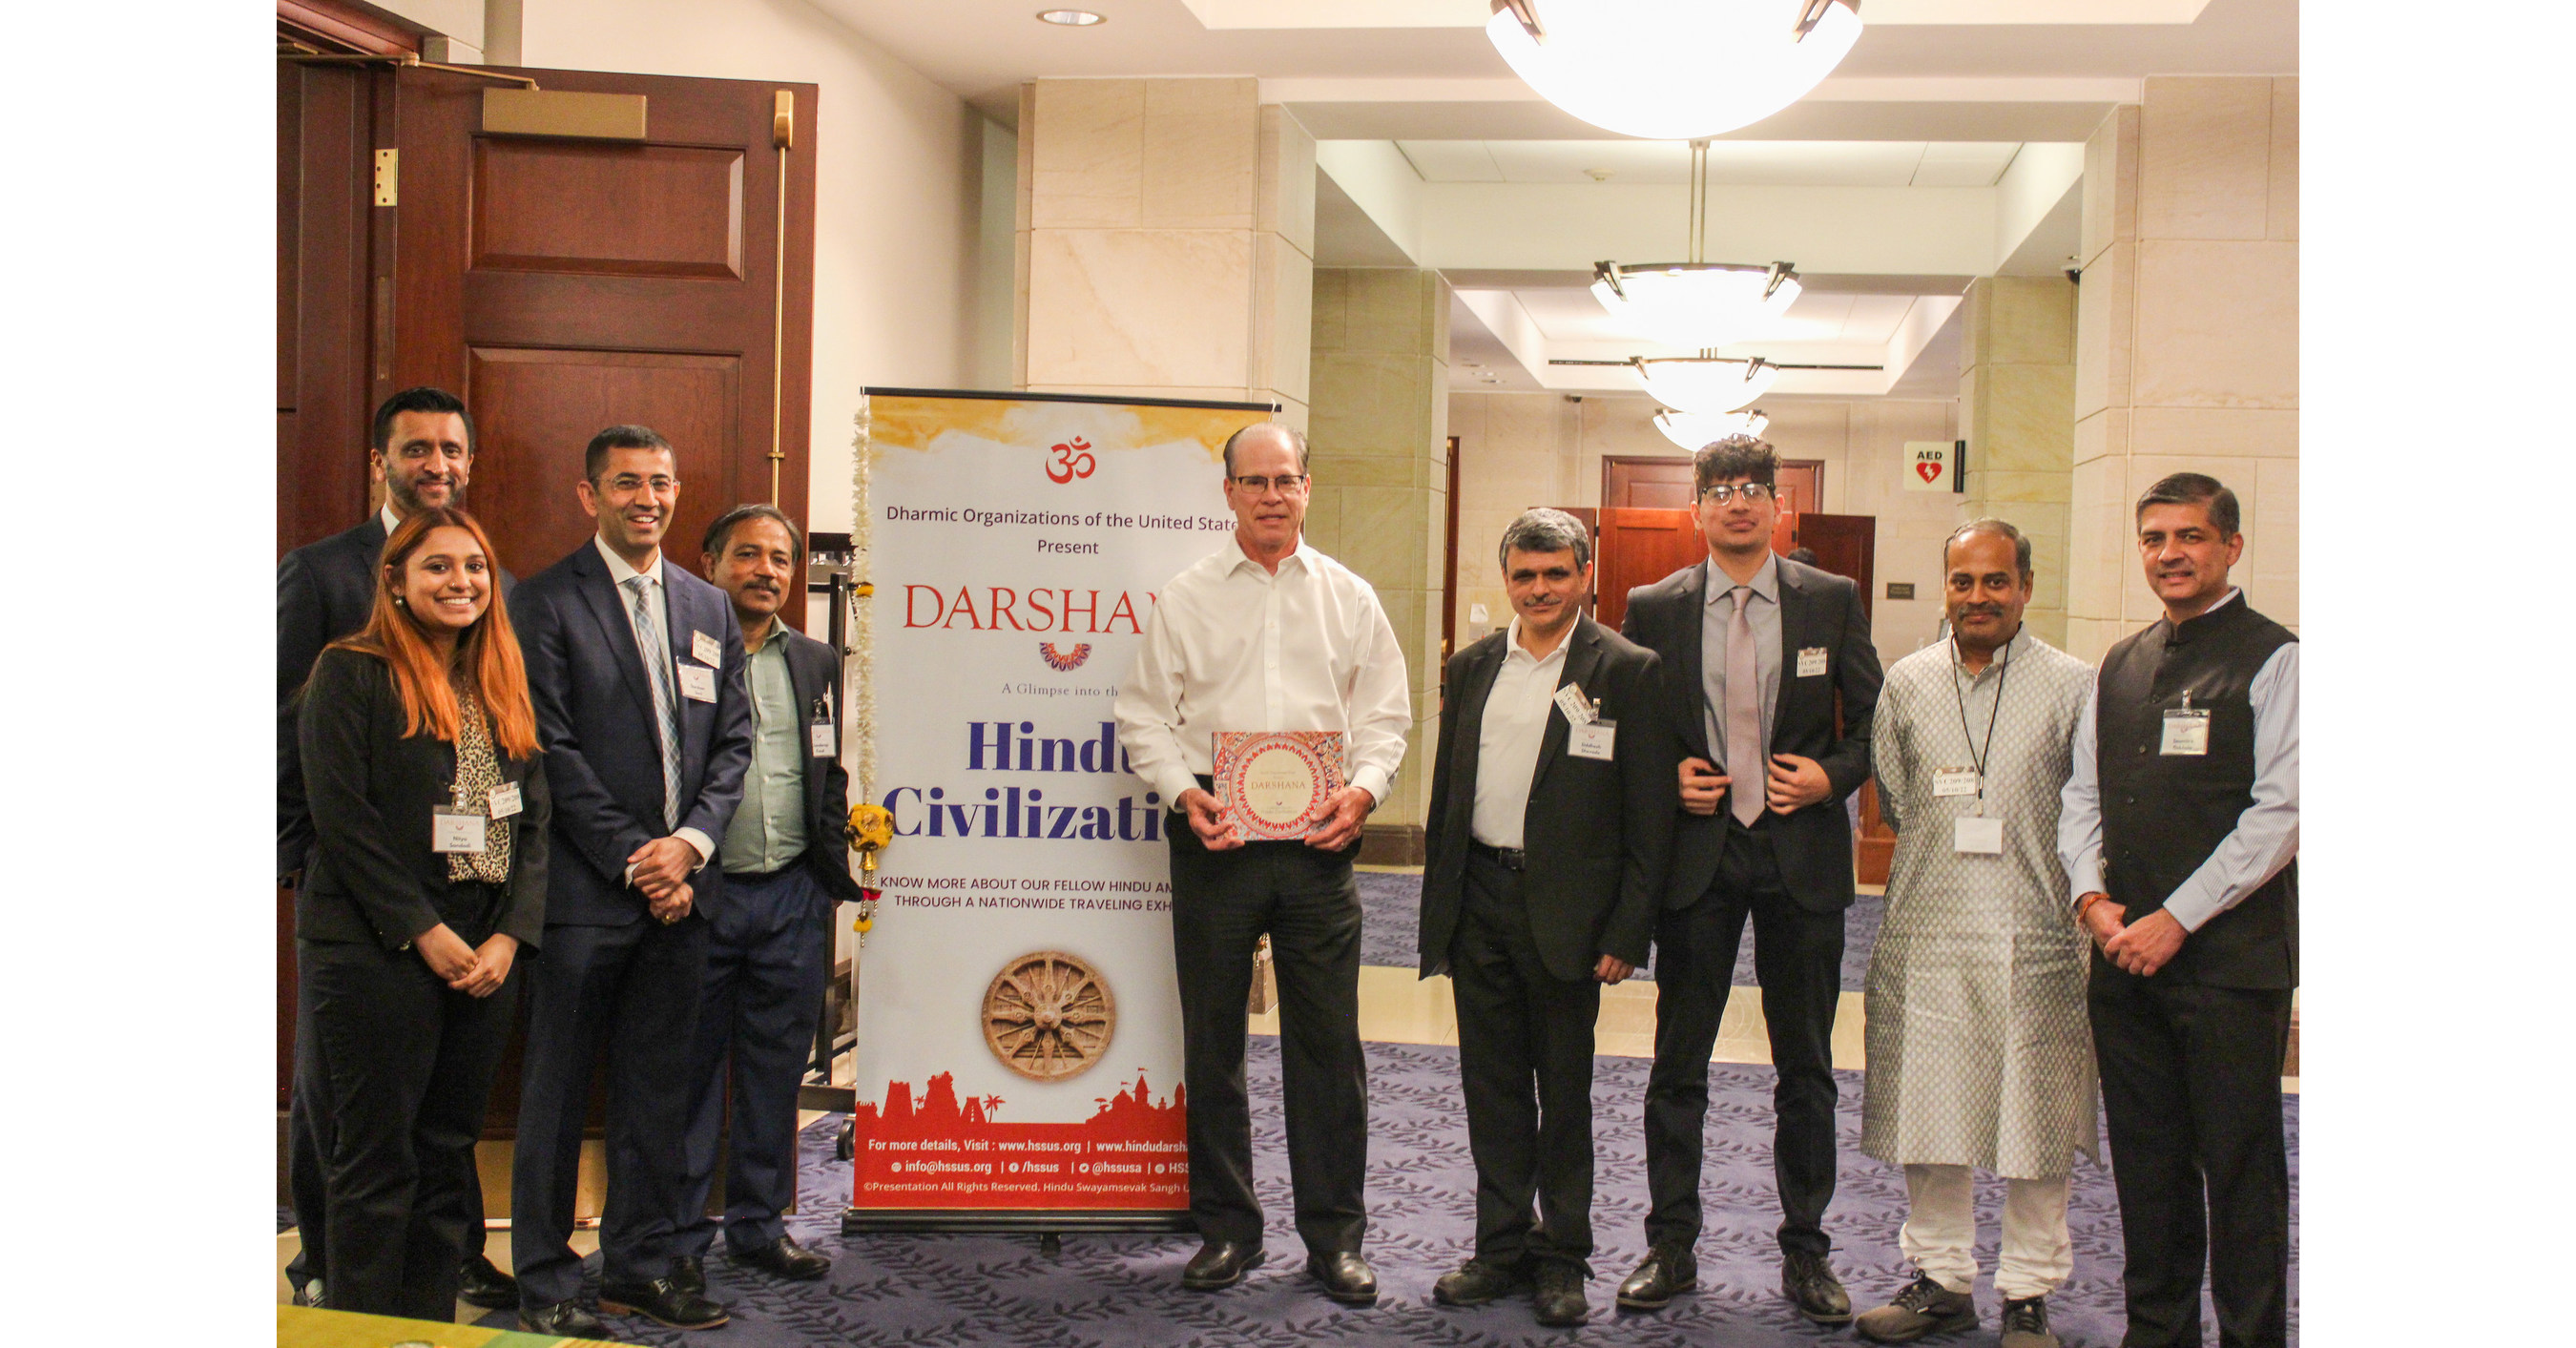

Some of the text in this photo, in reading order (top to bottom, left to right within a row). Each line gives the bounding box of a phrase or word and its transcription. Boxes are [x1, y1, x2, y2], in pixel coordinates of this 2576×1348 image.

[1917, 451, 1942, 460] AED
[886, 506, 958, 522] Dharmic
[963, 508, 1079, 527] Organizations
[1085, 512, 1102, 526] of
[1106, 513, 1133, 527] the
[1138, 514, 1193, 530] United
[1037, 539, 1099, 554] Present
[903, 584, 1156, 634] DARSHA
[1002, 683, 1118, 697] A Glimpse into th
[1251, 781, 1306, 790] DARSHANA
[882, 786, 1170, 841] Civilizati
[880, 877, 1173, 893] KNOW MORE ABOUT OUR FELLOW HINDU AM
[894, 895, 1173, 912] THROUGH A NATIONWIDE TRAVELING EXH
[868, 1139, 887, 1151] For
[889, 1142, 917, 1151] more
[920, 1139, 961, 1152] details,
[964, 1139, 988, 1151] Visit
[998, 1139, 1081, 1154] www.hssus.org
[905, 1160, 992, 1174] info@hssus.org
[1022, 1161, 1059, 1173] /hssus
[1092, 1161, 1142, 1175] @hssusa
[941, 1182, 954, 1192] All
[957, 1182, 988, 1193] Rights
[1043, 1182, 1074, 1192] Hindu
[1076, 1182, 1147, 1194] Swayamsevak
[1150, 1183, 1180, 1194] Sangh
